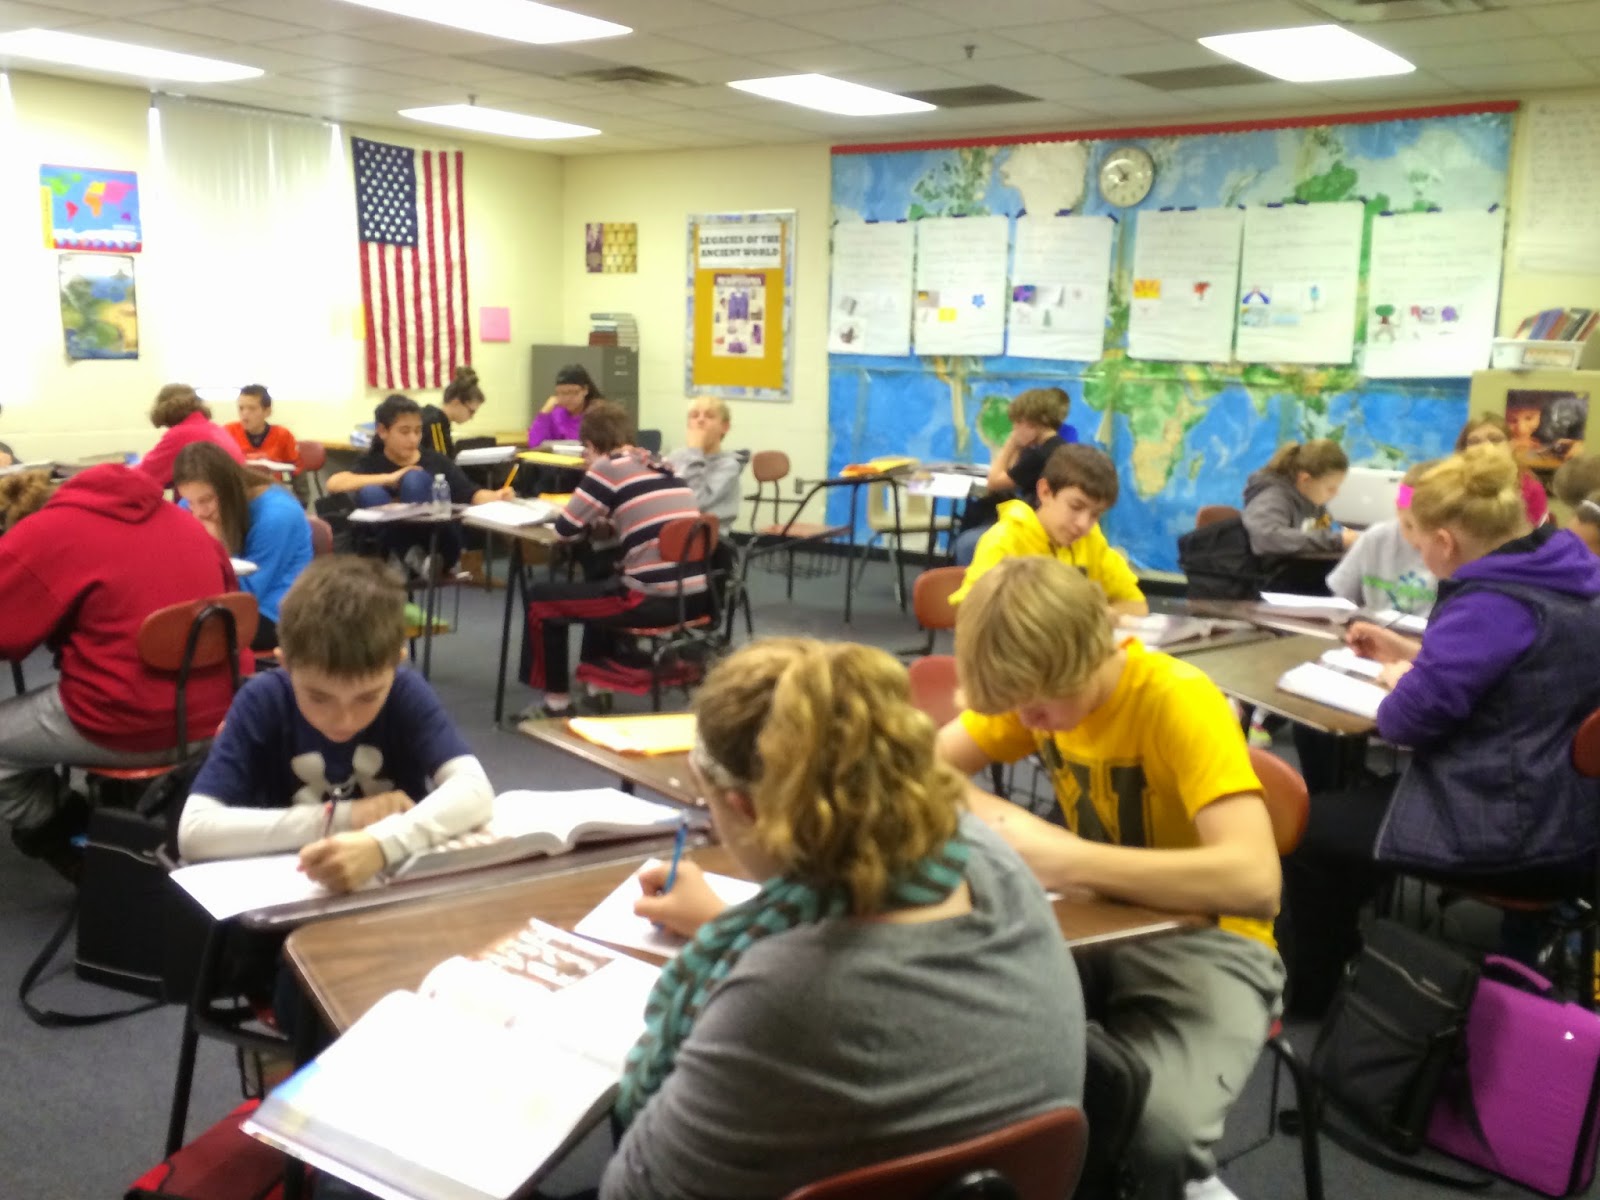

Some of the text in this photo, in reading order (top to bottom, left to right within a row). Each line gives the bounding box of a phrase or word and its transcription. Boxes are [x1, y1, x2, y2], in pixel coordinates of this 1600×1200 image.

[700, 235, 779, 245] LEGACIES OF THE
[702, 248, 779, 257] ANCIENT WORLD
